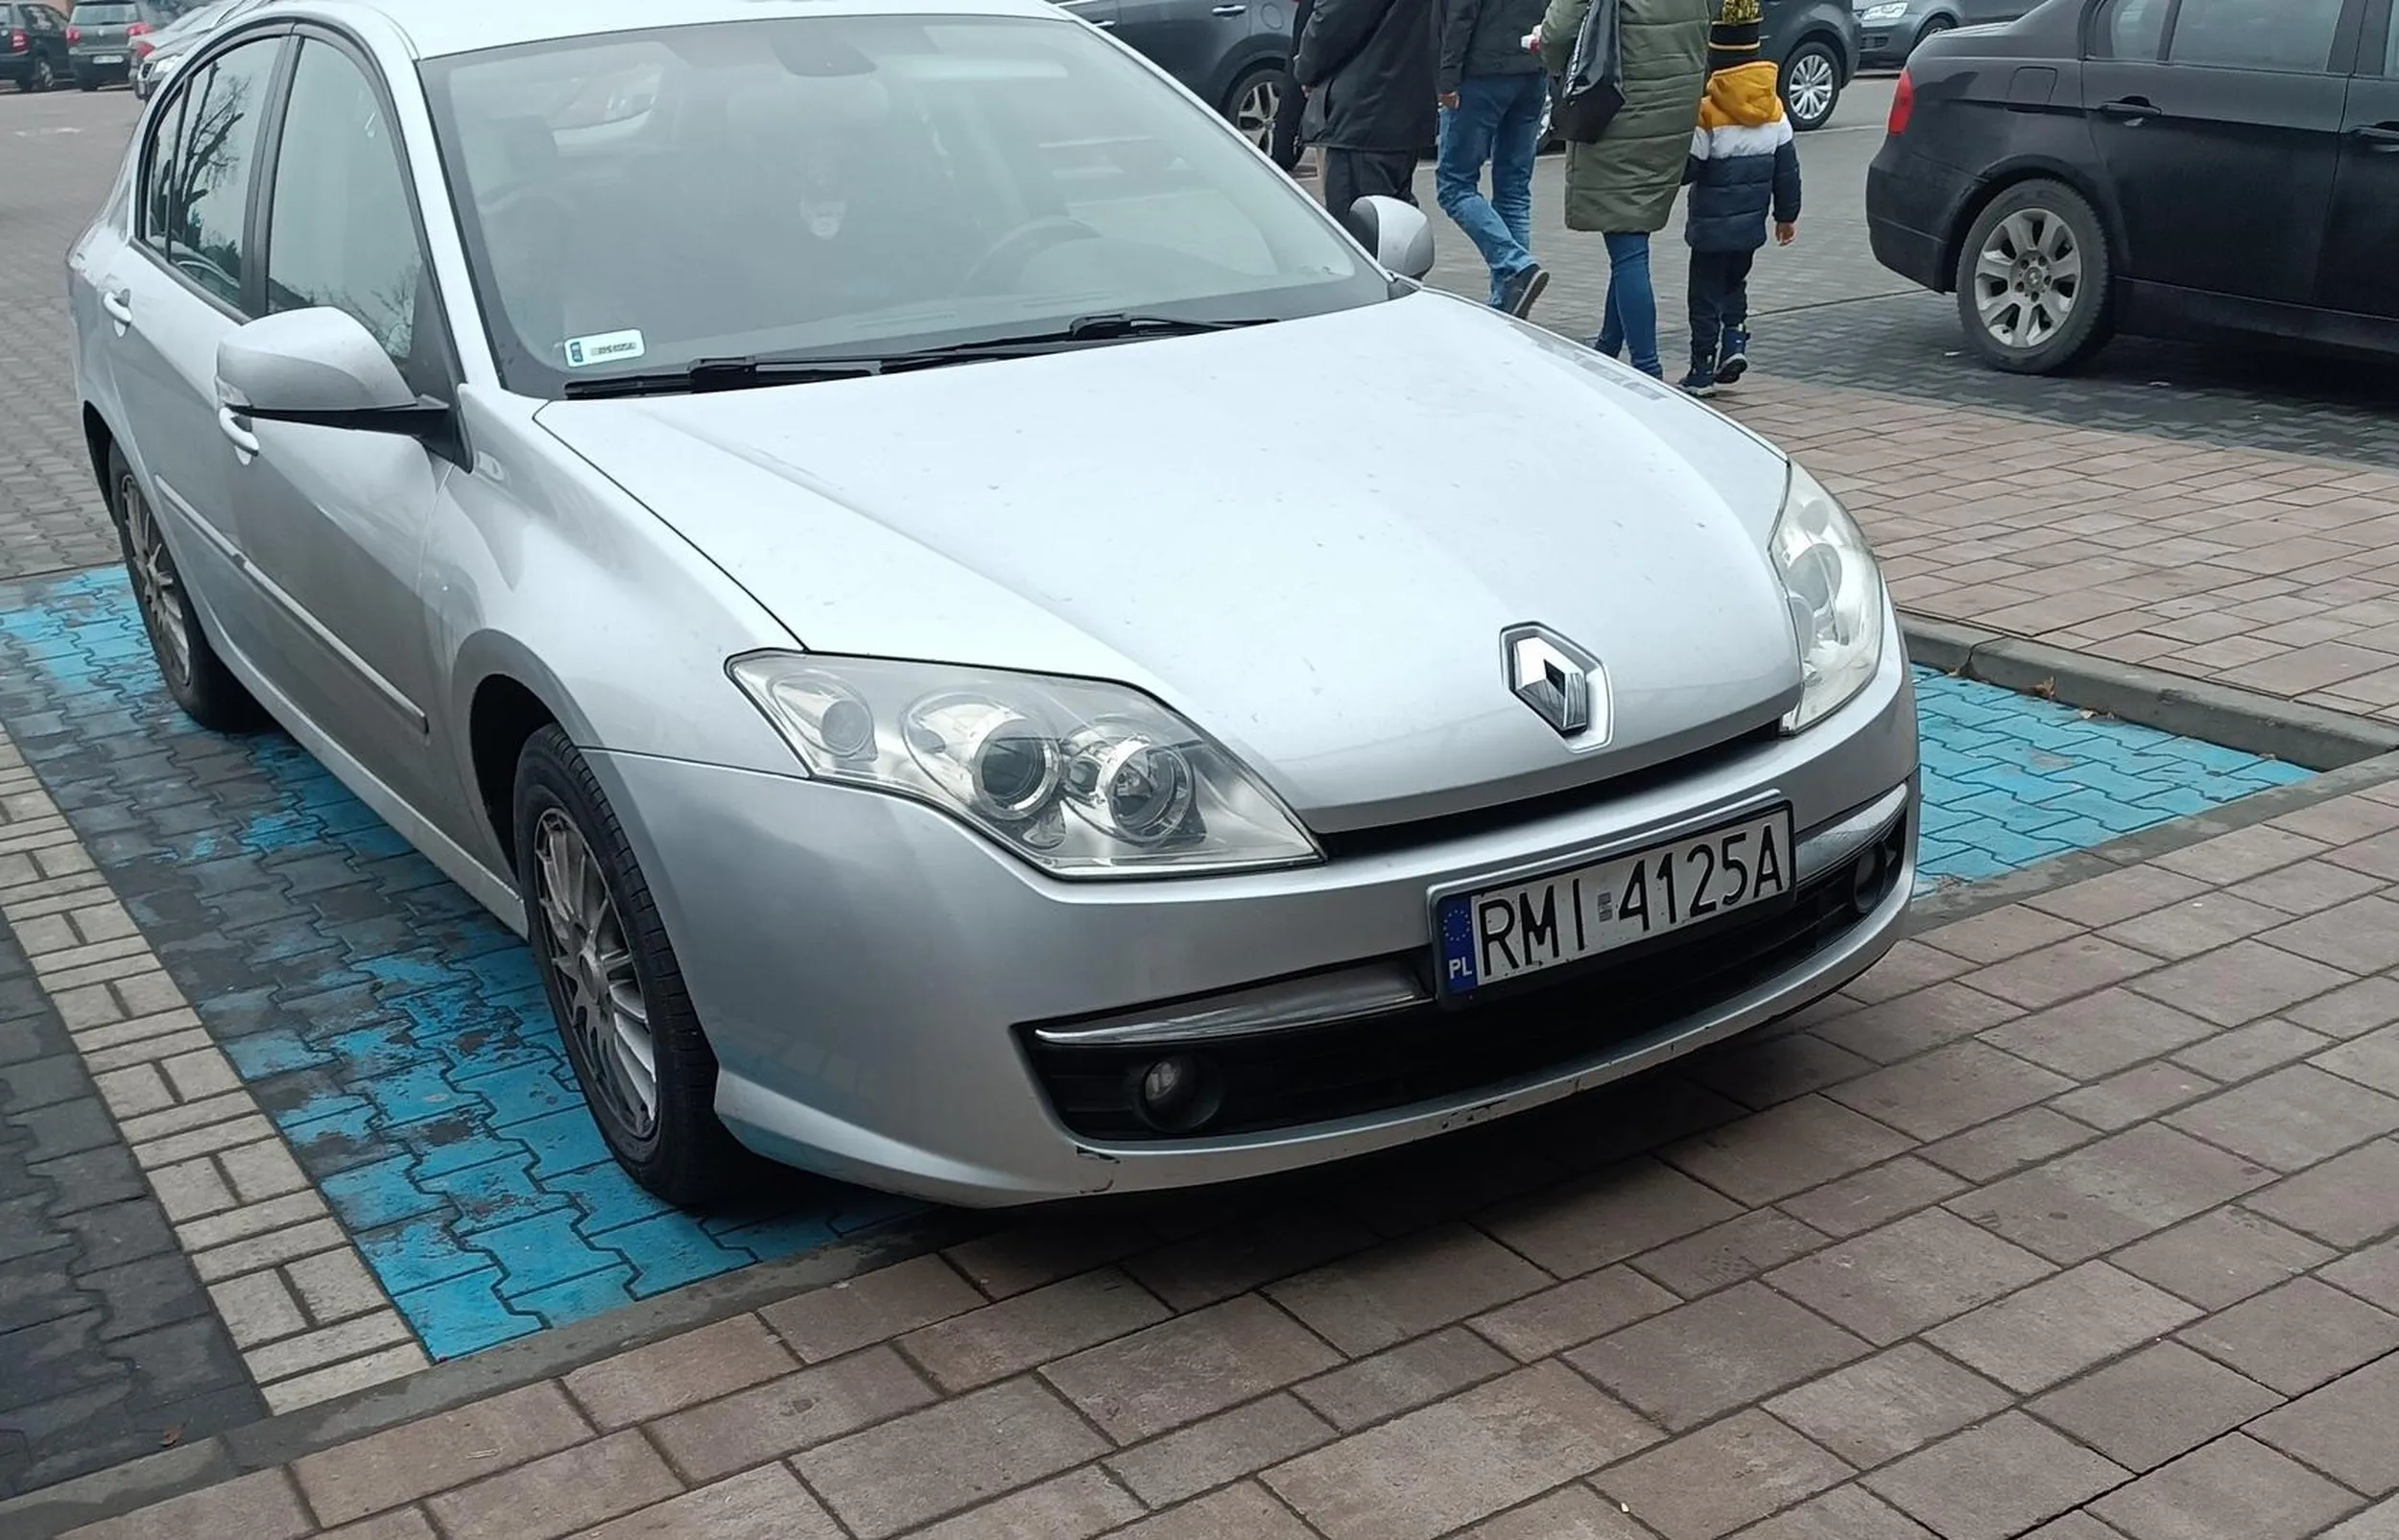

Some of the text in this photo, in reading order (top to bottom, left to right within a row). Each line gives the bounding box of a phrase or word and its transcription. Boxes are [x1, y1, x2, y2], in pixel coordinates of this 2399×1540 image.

[1478, 824, 1784, 977] RMI 4125A
[1448, 956, 1473, 980] PL
